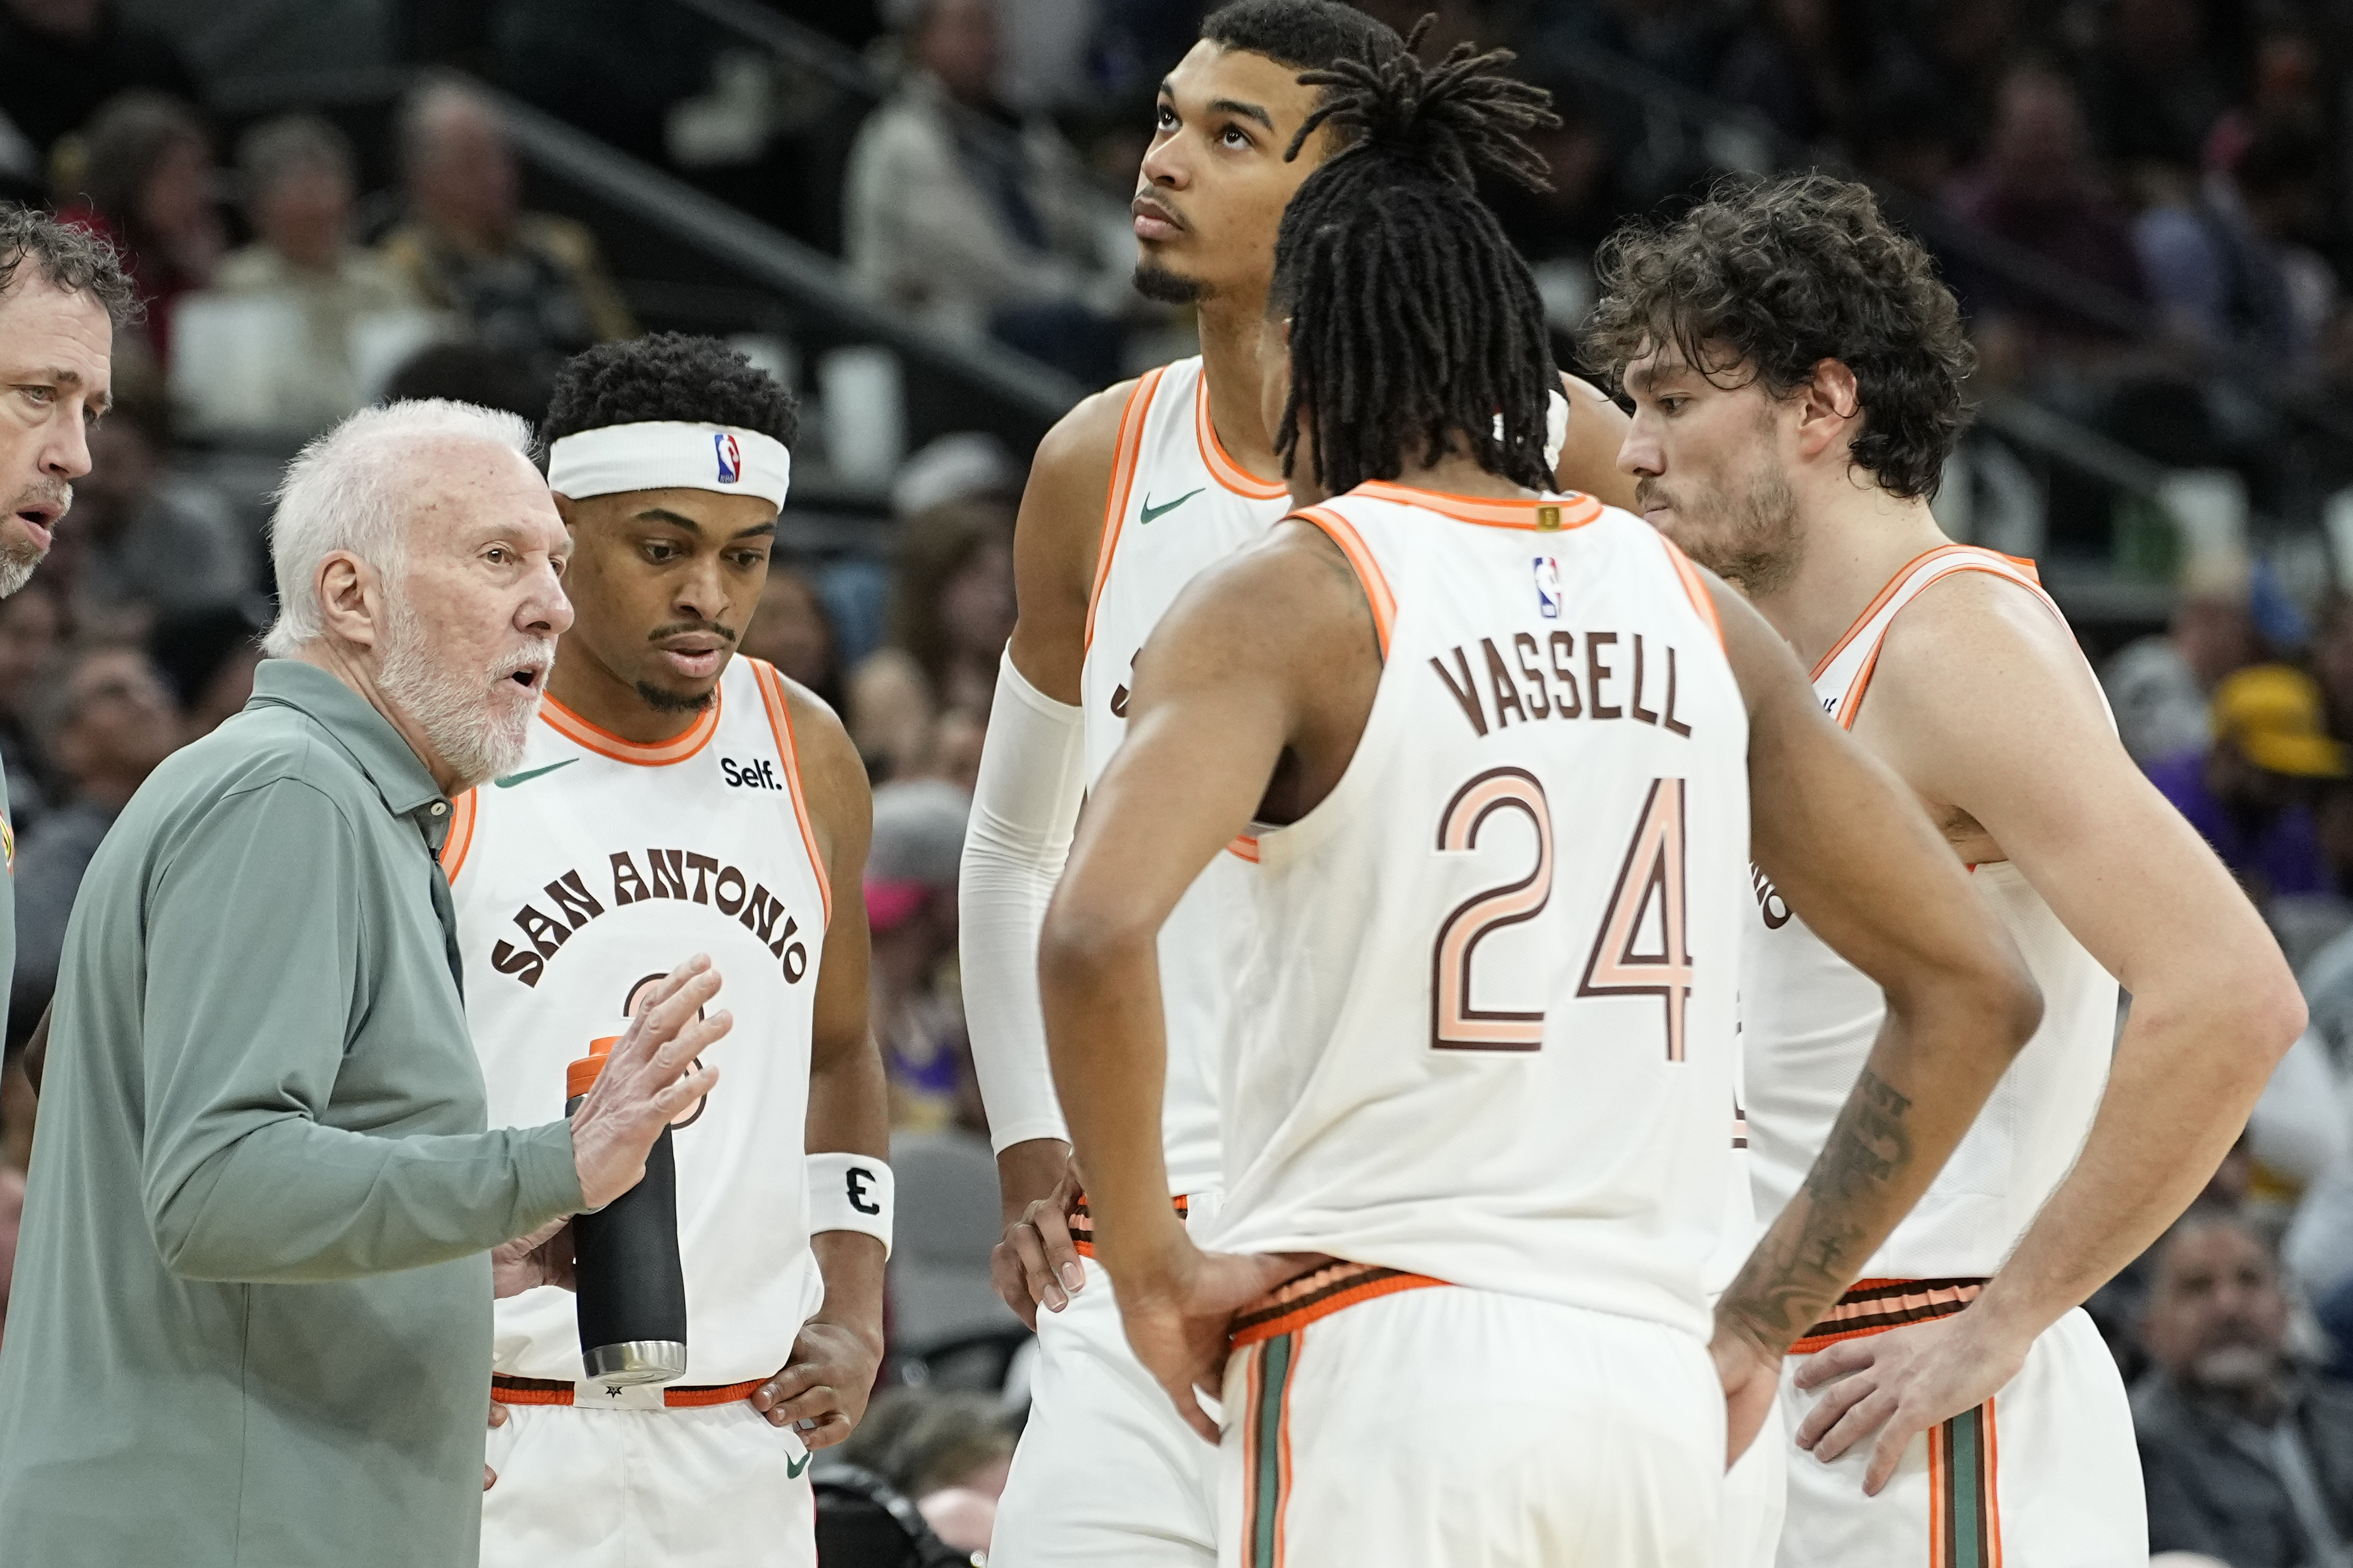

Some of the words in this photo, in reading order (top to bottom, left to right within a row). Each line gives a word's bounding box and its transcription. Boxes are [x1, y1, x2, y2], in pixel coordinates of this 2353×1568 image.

[1429, 630, 1692, 738] VASSELL
[720, 757, 783, 790] Self.
[491, 869, 605, 988] SAN
[609, 848, 807, 985] ANTONIO
[1430, 766, 1693, 1061] 24
